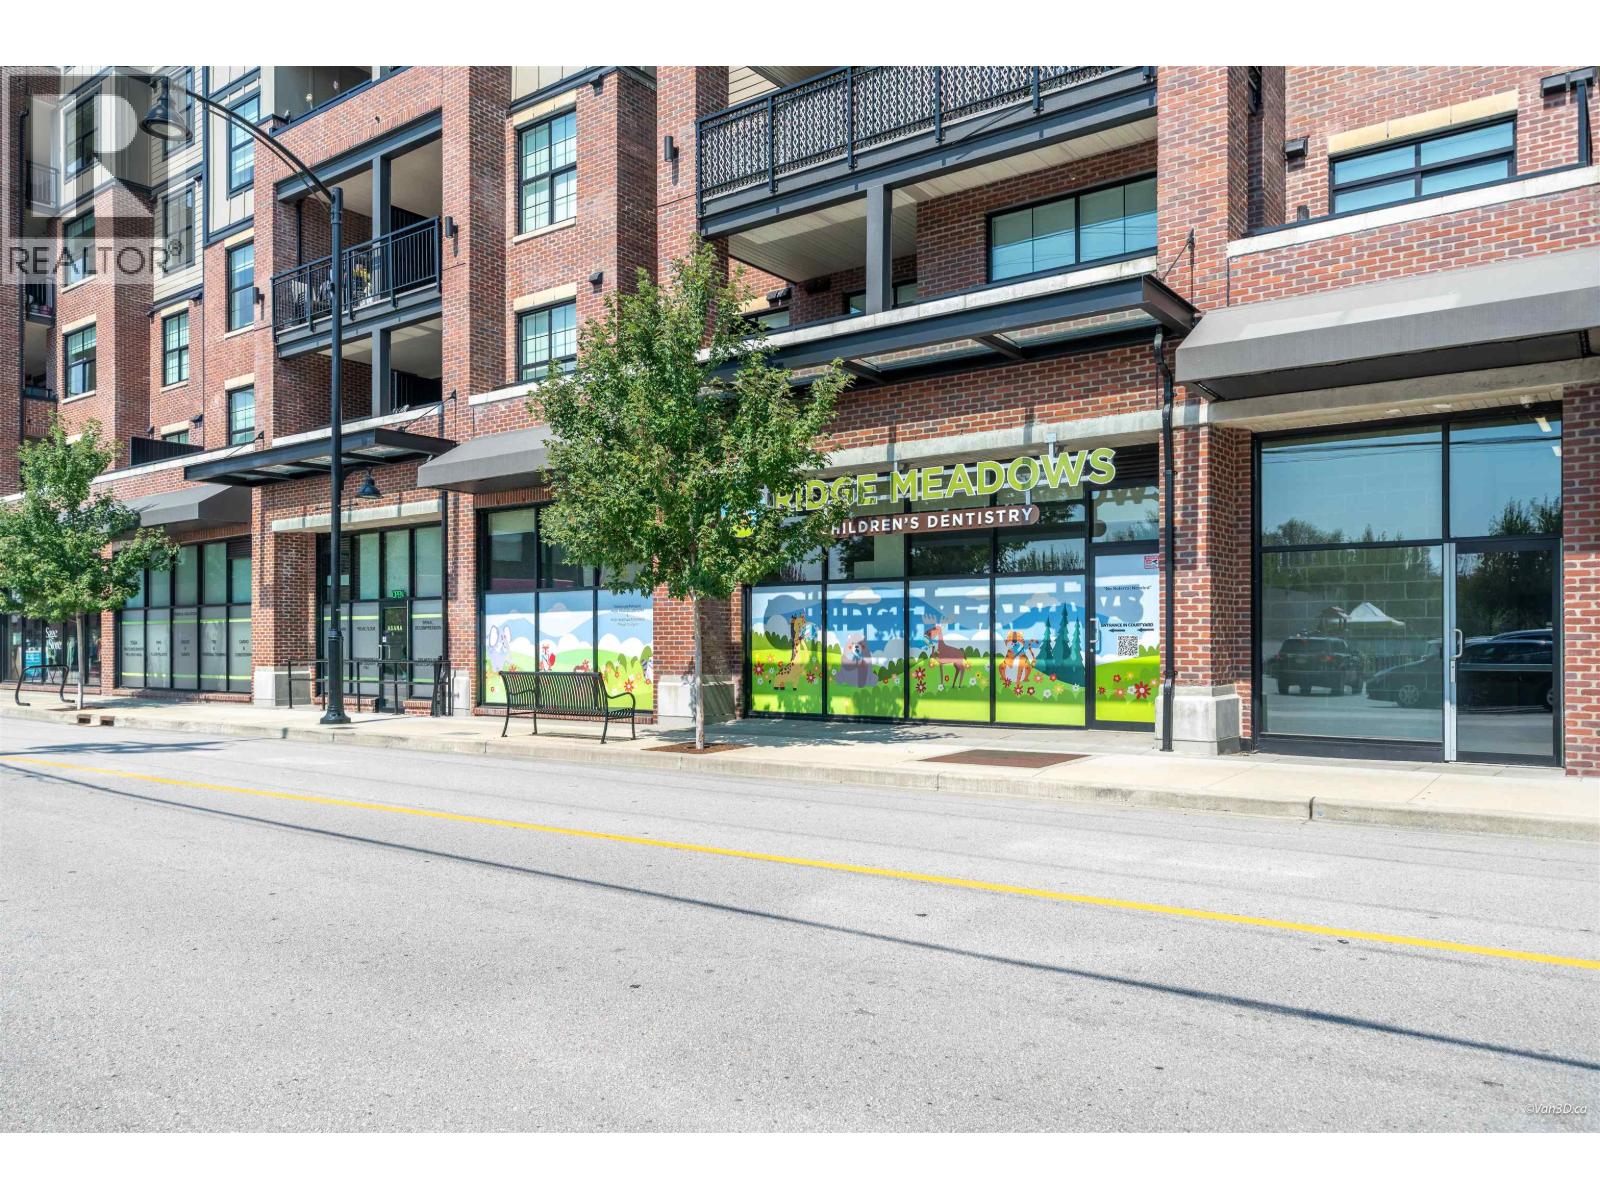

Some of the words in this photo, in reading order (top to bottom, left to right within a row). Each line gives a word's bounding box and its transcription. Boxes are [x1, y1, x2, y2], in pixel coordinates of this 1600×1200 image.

[775, 473, 878, 511] RIDGE
[890, 448, 1116, 503] MEADOWS
[821, 516, 920, 537] HILDREN'S
[928, 507, 1033, 529] DENTISTRY
